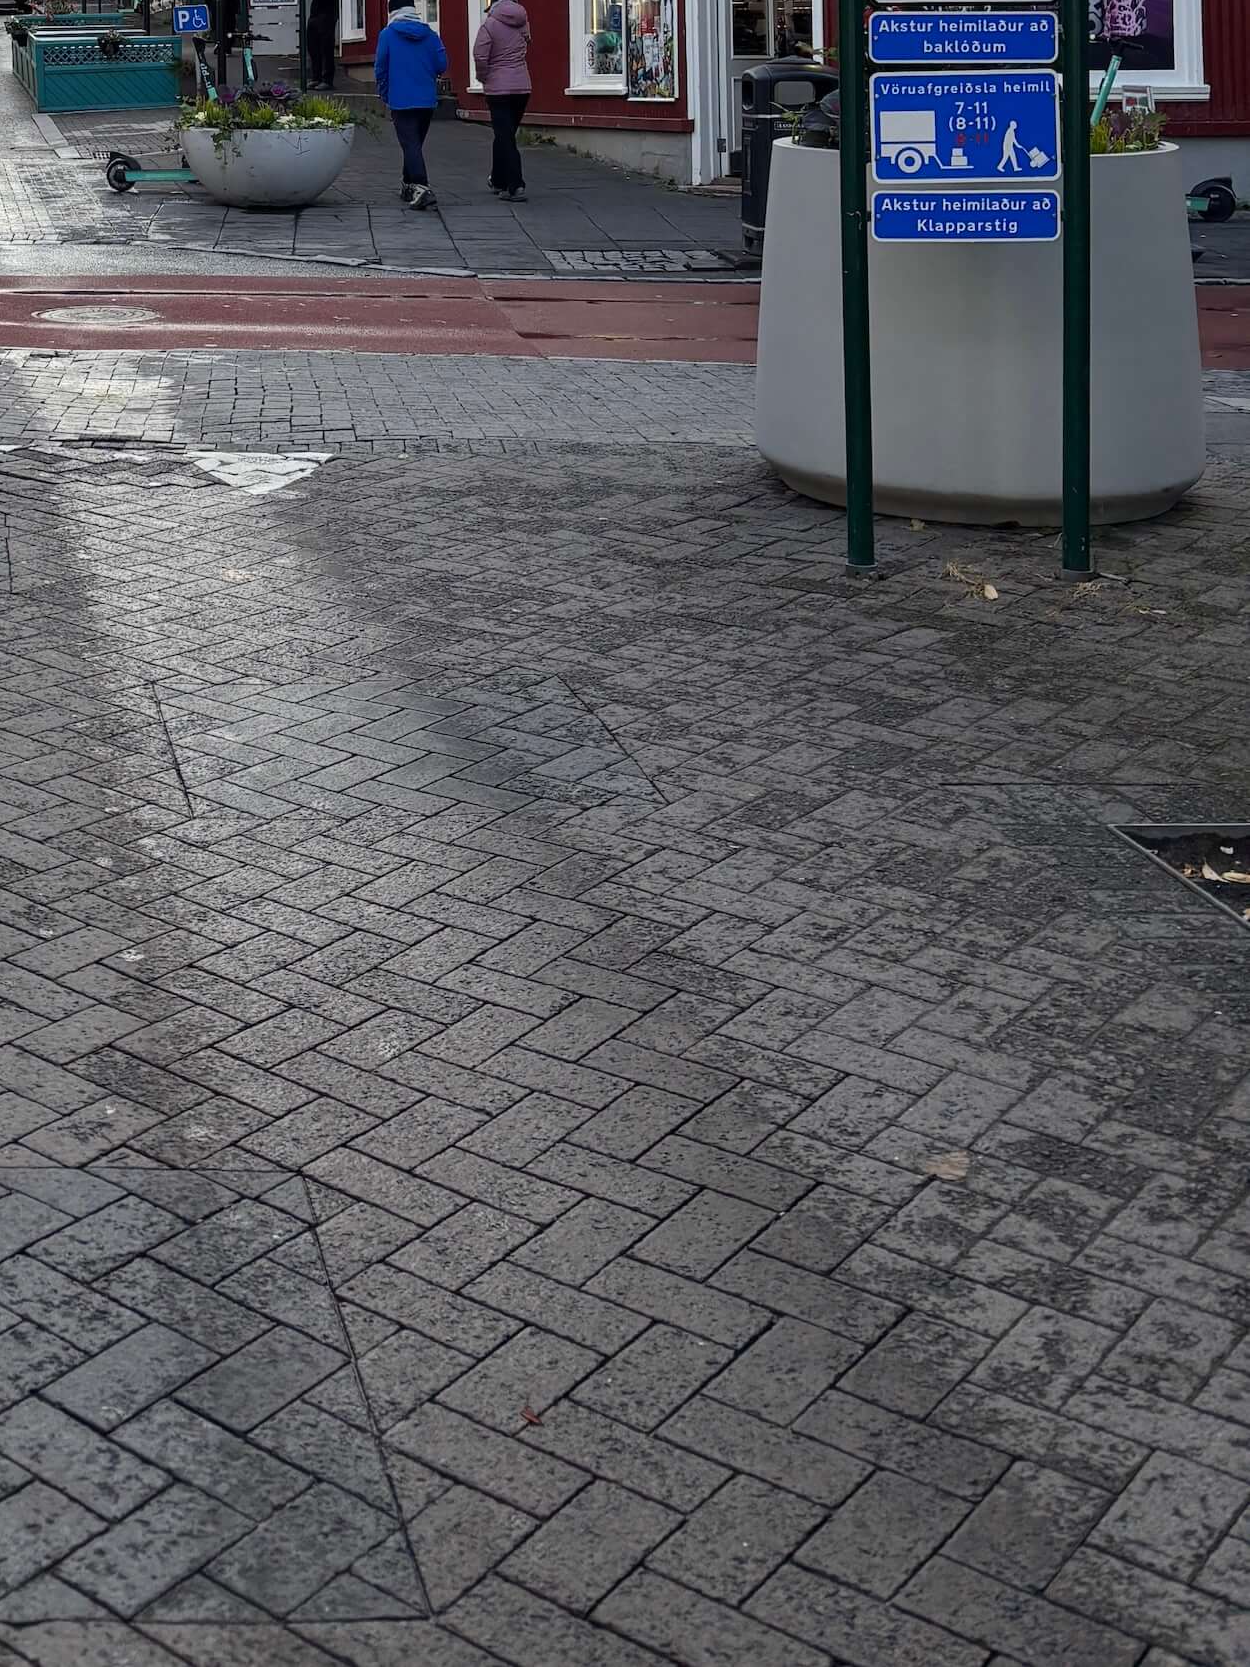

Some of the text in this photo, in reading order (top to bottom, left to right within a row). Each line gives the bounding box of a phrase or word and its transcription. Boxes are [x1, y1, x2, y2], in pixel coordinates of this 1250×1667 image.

[178, 10, 190, 29] P
[879, 19, 1048, 32] Akstur heimilaður að
[923, 40, 1006, 53] baklóðum
[880, 81, 1050, 96] Vöruafgreiðsla heimil
[955, 101, 988, 114] 7-11
[949, 116, 996, 132] (8-11)
[881, 198, 1051, 211] Akstur heimilaður að
